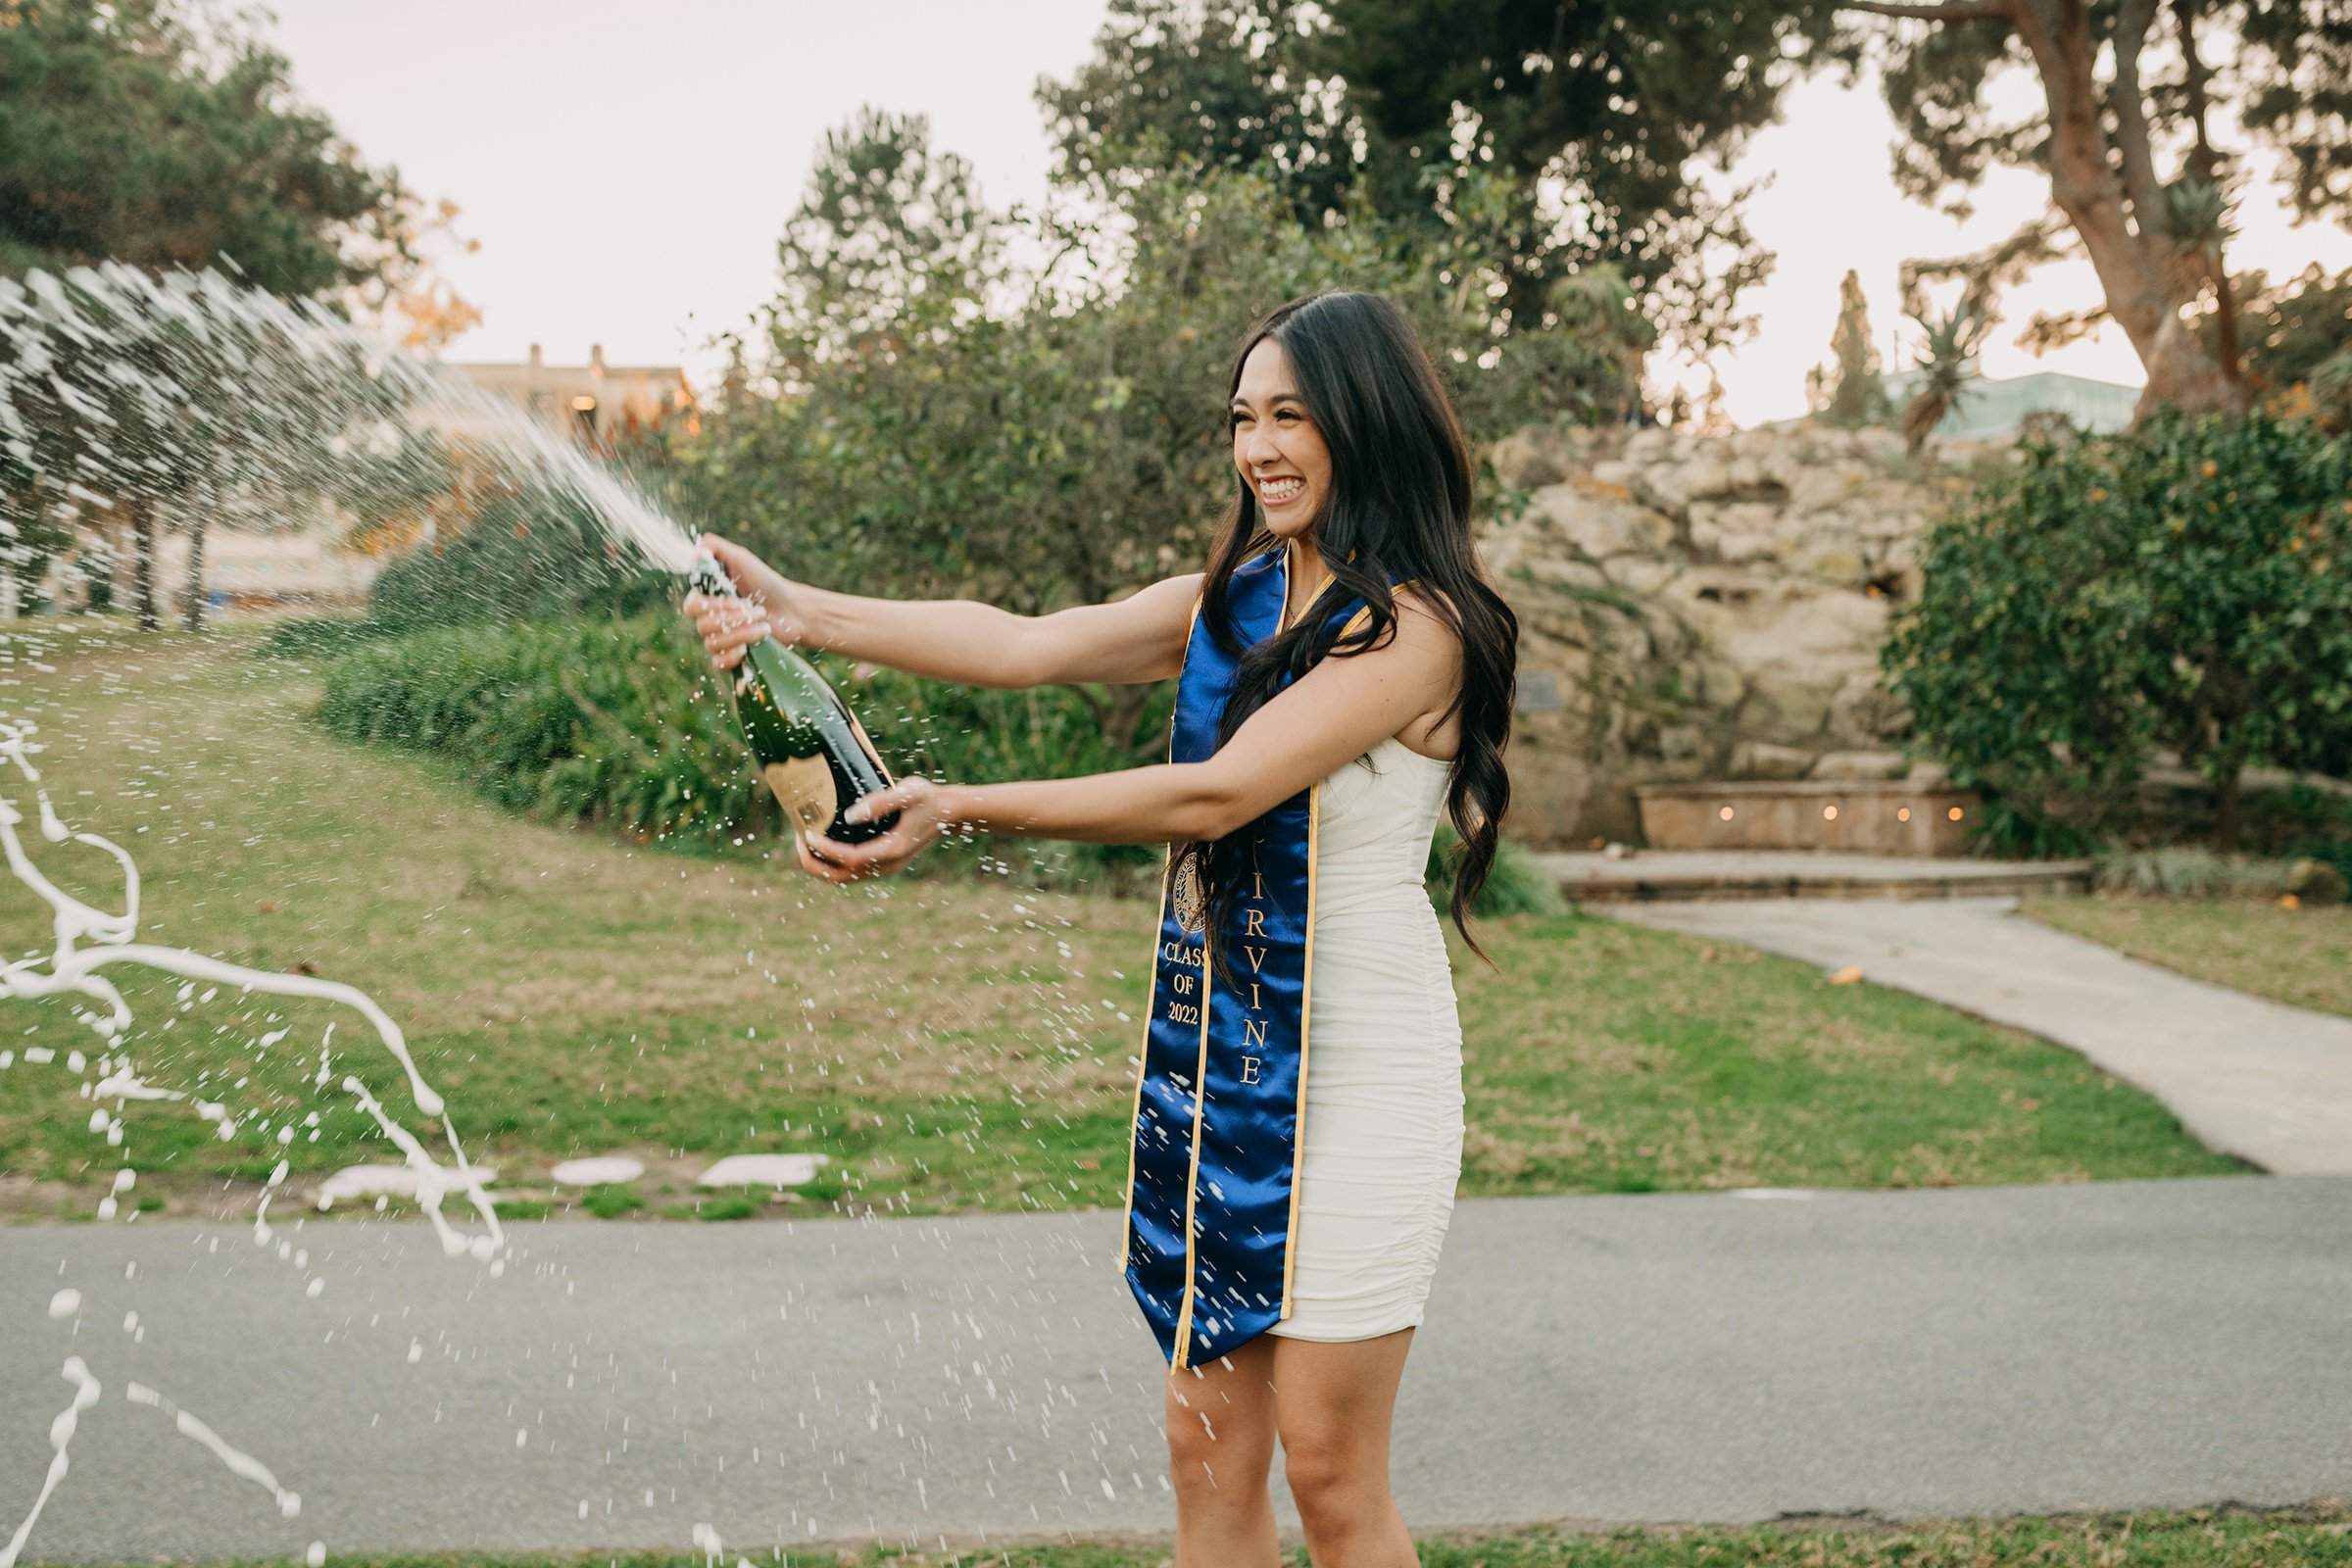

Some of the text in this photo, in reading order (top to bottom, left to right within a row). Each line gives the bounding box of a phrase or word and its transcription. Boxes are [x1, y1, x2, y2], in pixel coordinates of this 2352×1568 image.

[1173, 973, 1194, 995] OF
[1240, 872, 1268, 1085] IRVINE
[1168, 1001, 1199, 1025] 2022
